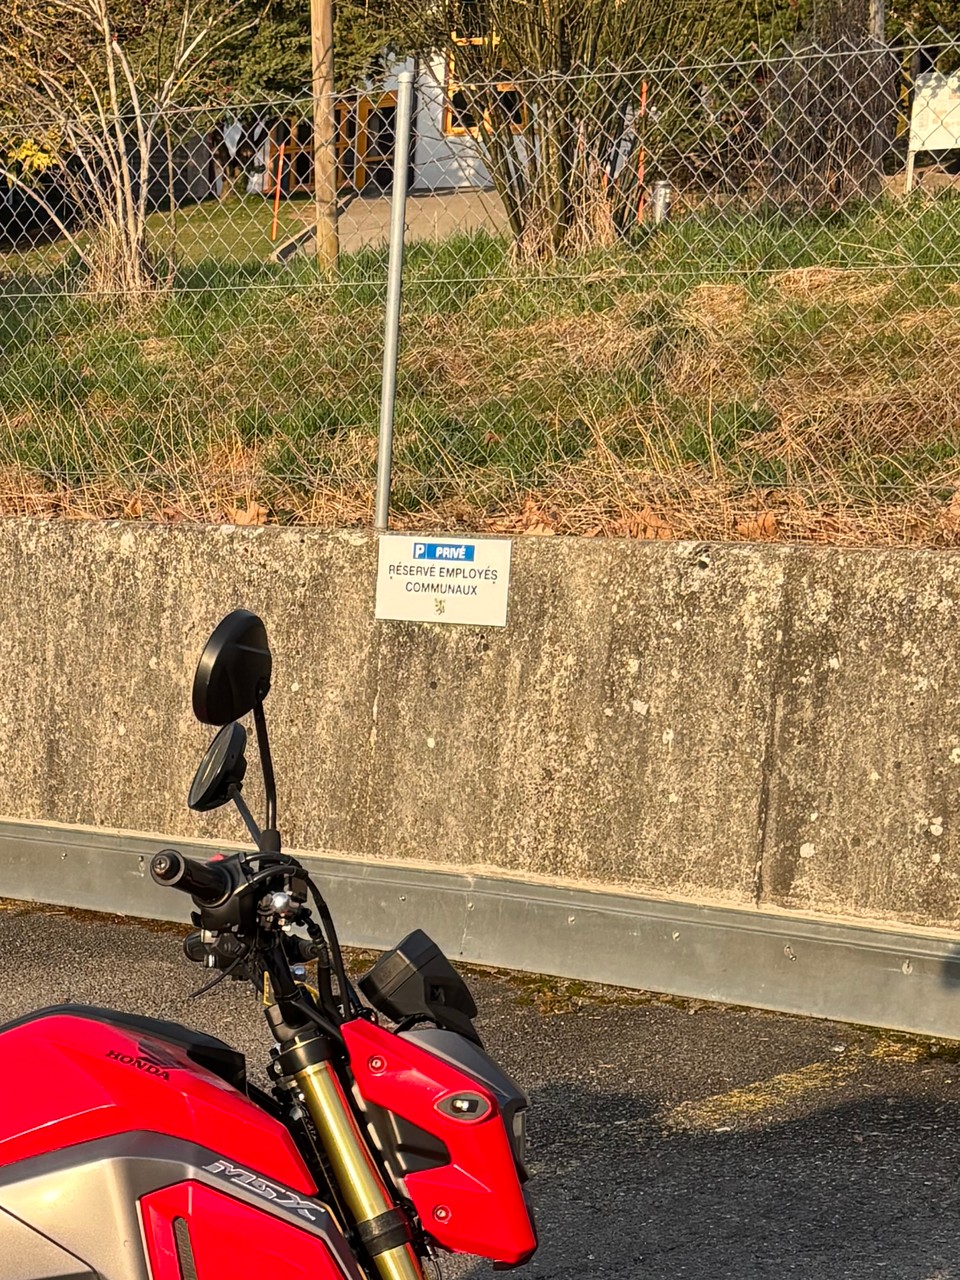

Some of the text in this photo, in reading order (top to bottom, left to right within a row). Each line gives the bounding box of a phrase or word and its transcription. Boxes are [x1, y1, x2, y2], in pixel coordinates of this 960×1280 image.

[415, 544, 467, 559] P PRIVÉ
[388, 562, 498, 581] RÉSERVÉ EMPLOYÉS
[405, 581, 478, 596] COMMUNAUX
[105, 1049, 171, 1082] HONDA
[202, 1159, 327, 1222] MSX
